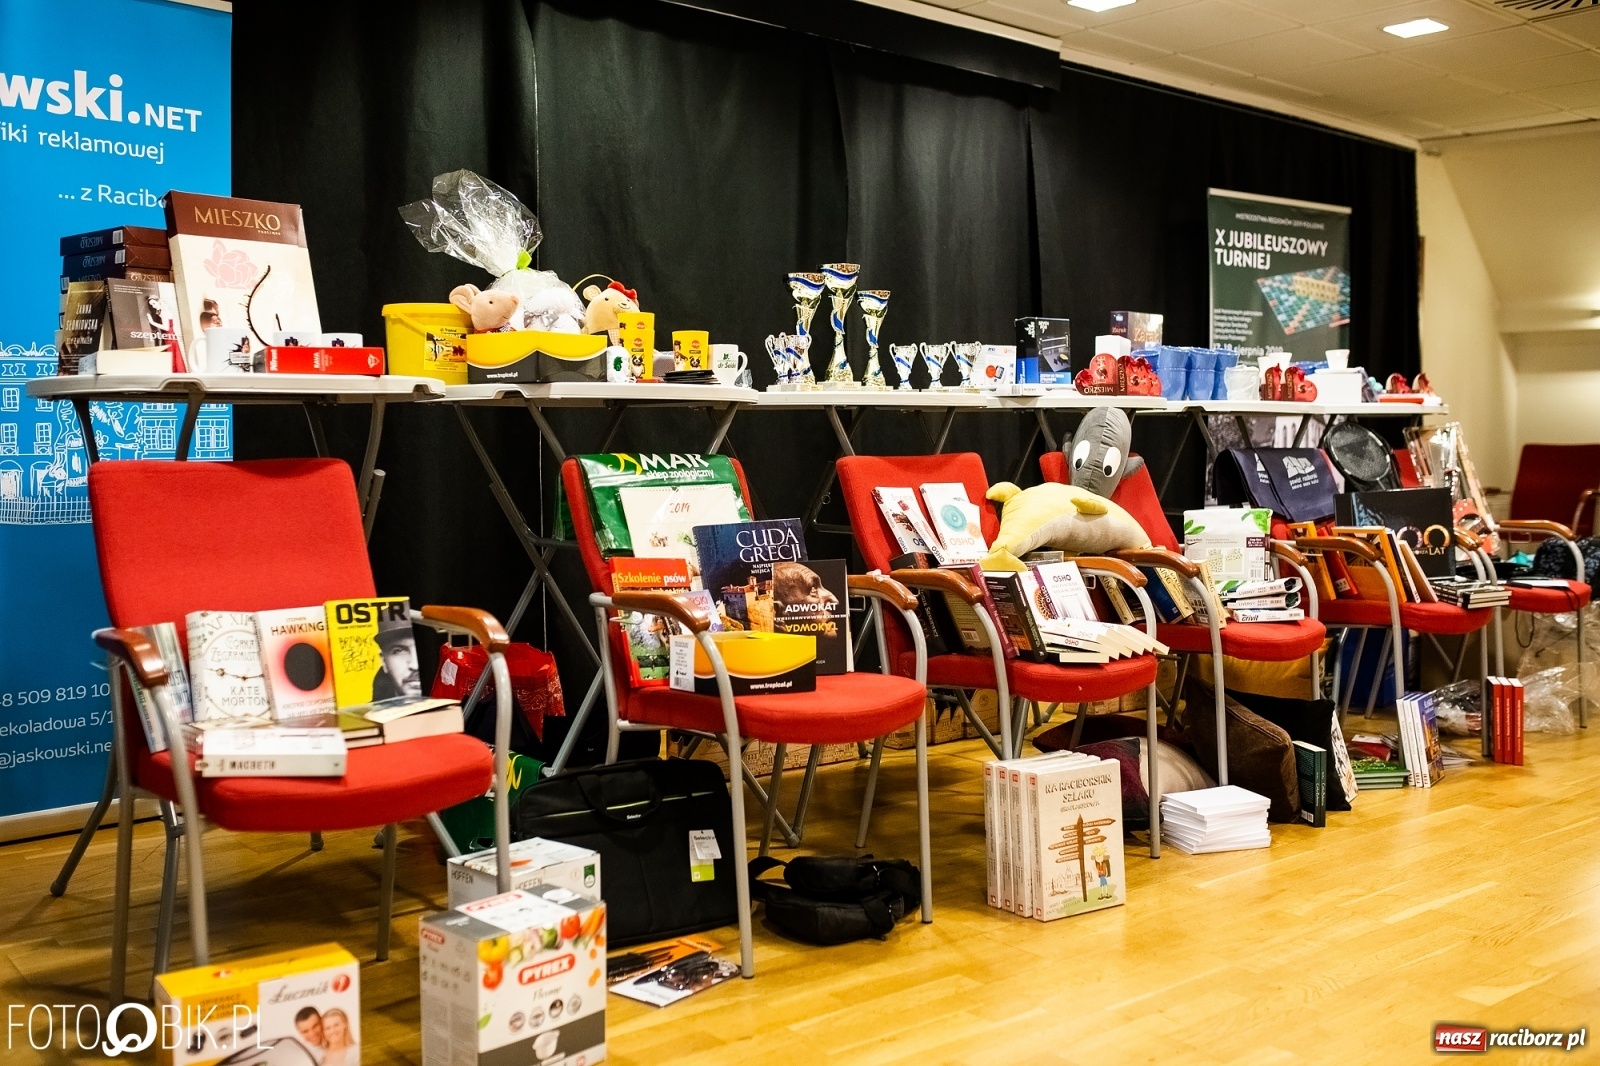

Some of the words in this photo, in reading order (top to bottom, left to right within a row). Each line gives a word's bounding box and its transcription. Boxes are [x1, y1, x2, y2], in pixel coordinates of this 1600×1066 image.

[38, 129, 164, 165] reklamowej
[80, 187, 93, 201] z
[194, 206, 281, 231] MIESZKO
[1215, 228, 1225, 246] X
[1227, 230, 1328, 257] JUBILEUSZOWY
[1214, 248, 1271, 270] TURNIEJ
[1084, 386, 1114, 394] MIESZKO
[646, 469, 669, 480] sklep
[669, 468, 715, 479] zoologiczny
[669, 502, 691, 514] 2019
[735, 527, 799, 547] CUDA
[897, 536, 908, 553] OSHO
[939, 532, 948, 551] OSHO
[949, 537, 975, 546] OSHO
[739, 543, 802, 563] GRECJI
[931, 545, 945, 563] OSHO
[1429, 547, 1445, 555] LAT
[617, 573, 661, 584] Szkolenie
[663, 572, 687, 587] psów
[1052, 574, 1072, 583] OSHO
[1041, 585, 1051, 603] OSHO
[335, 602, 408, 624] OSTR
[785, 602, 838, 613] ADWOKAT
[271, 621, 325, 636] HAWKING
[1064, 638, 1079, 646] OSHO
[230, 686, 260, 696] KATE
[749, 680, 793, 690] www.tropical.pl
[0, 692, 13, 707] 8
[17, 689, 51, 706] 509
[55, 685, 87, 701] 819
[221, 696, 268, 707] MORTON
[0, 717, 86, 737] ekoladowa
[229, 760, 276, 770] MACBETH
[1062, 789, 1095, 803] SZLAKU
[451, 869, 474, 884] HOFFEN
[521, 956, 572, 984] PYREX
